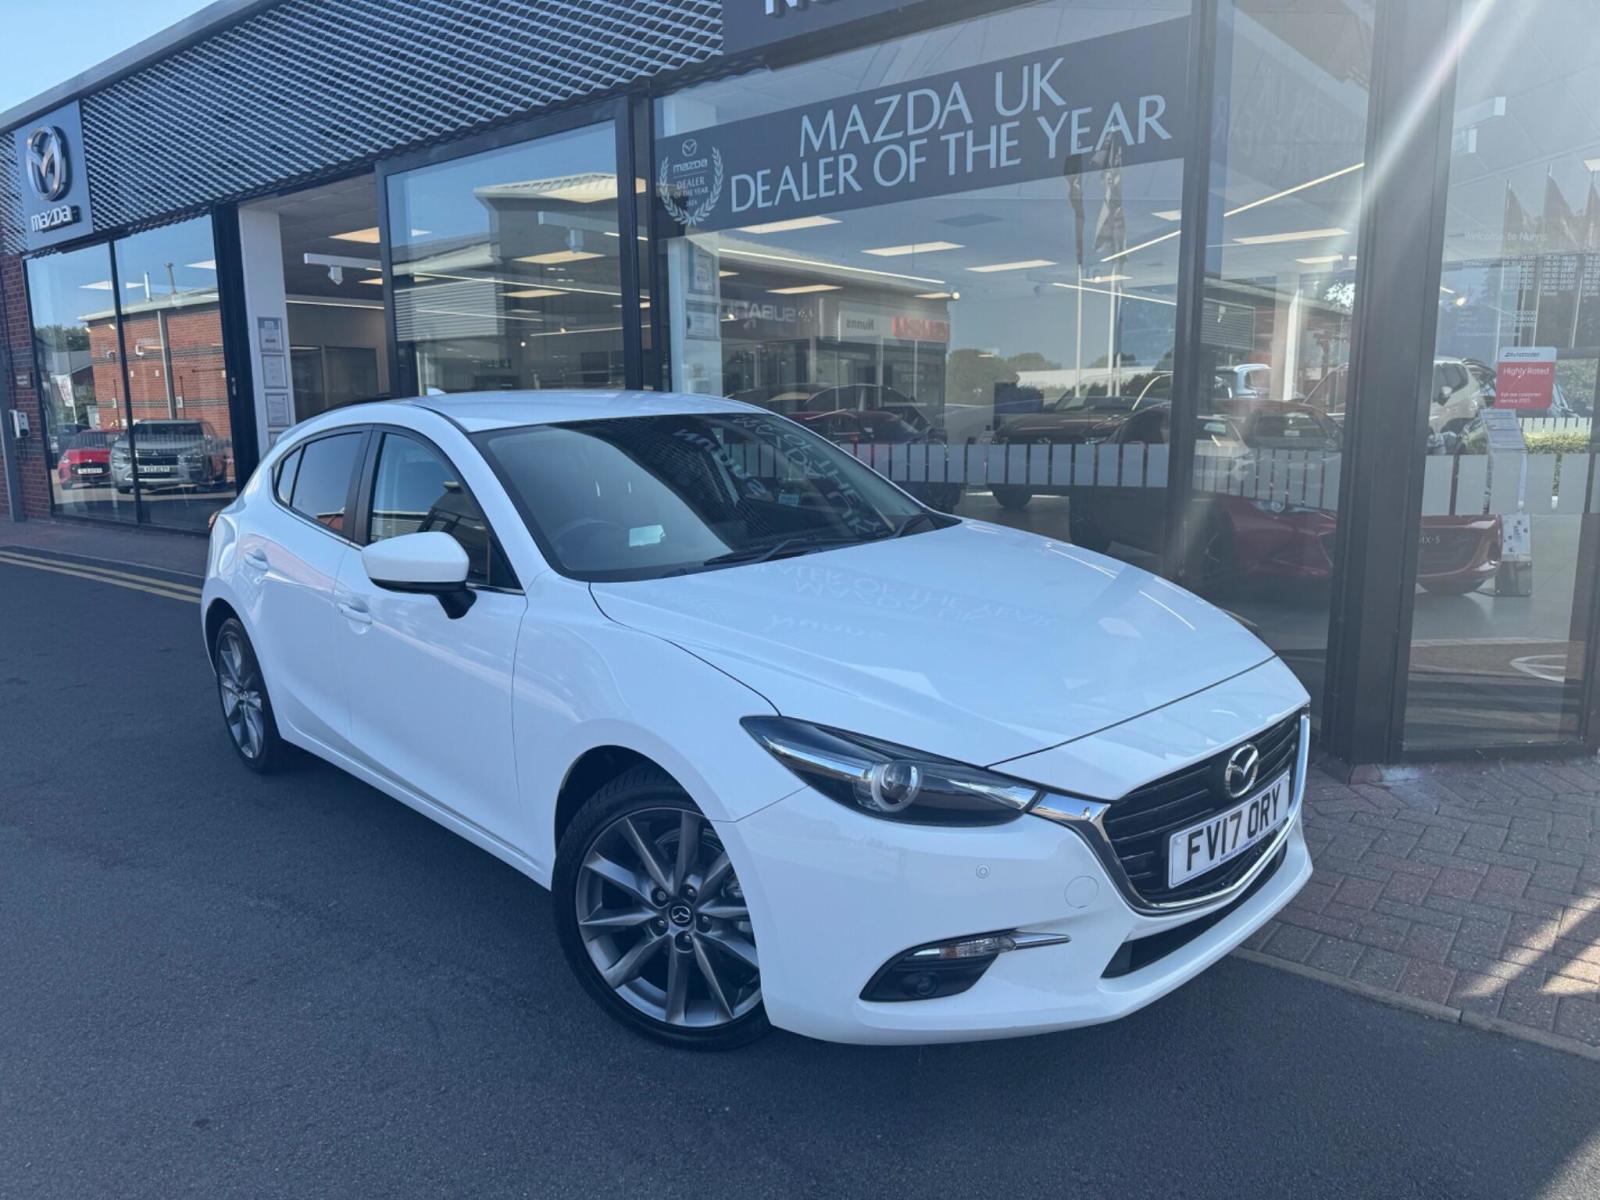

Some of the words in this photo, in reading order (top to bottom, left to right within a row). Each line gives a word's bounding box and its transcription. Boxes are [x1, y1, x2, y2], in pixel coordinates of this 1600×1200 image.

[799, 81, 974, 158] MAZDA
[995, 57, 1067, 117] UK
[731, 153, 863, 213] DEALER
[872, 138, 928, 187] OF
[939, 120, 1023, 176] THE
[1036, 94, 1174, 159] YEAR
[672, 158, 708, 174] mazda
[676, 176, 705, 189] DEALER
[683, 189, 693, 197] THE
[694, 186, 709, 195] YEAR
[31, 204, 73, 232] mazda
[1507, 232, 1517, 241] to
[1503, 367, 1526, 377] Highly
[1527, 367, 1550, 375] Rated
[1186, 810, 1243, 873] FV17
[1248, 783, 1281, 839] ORY
